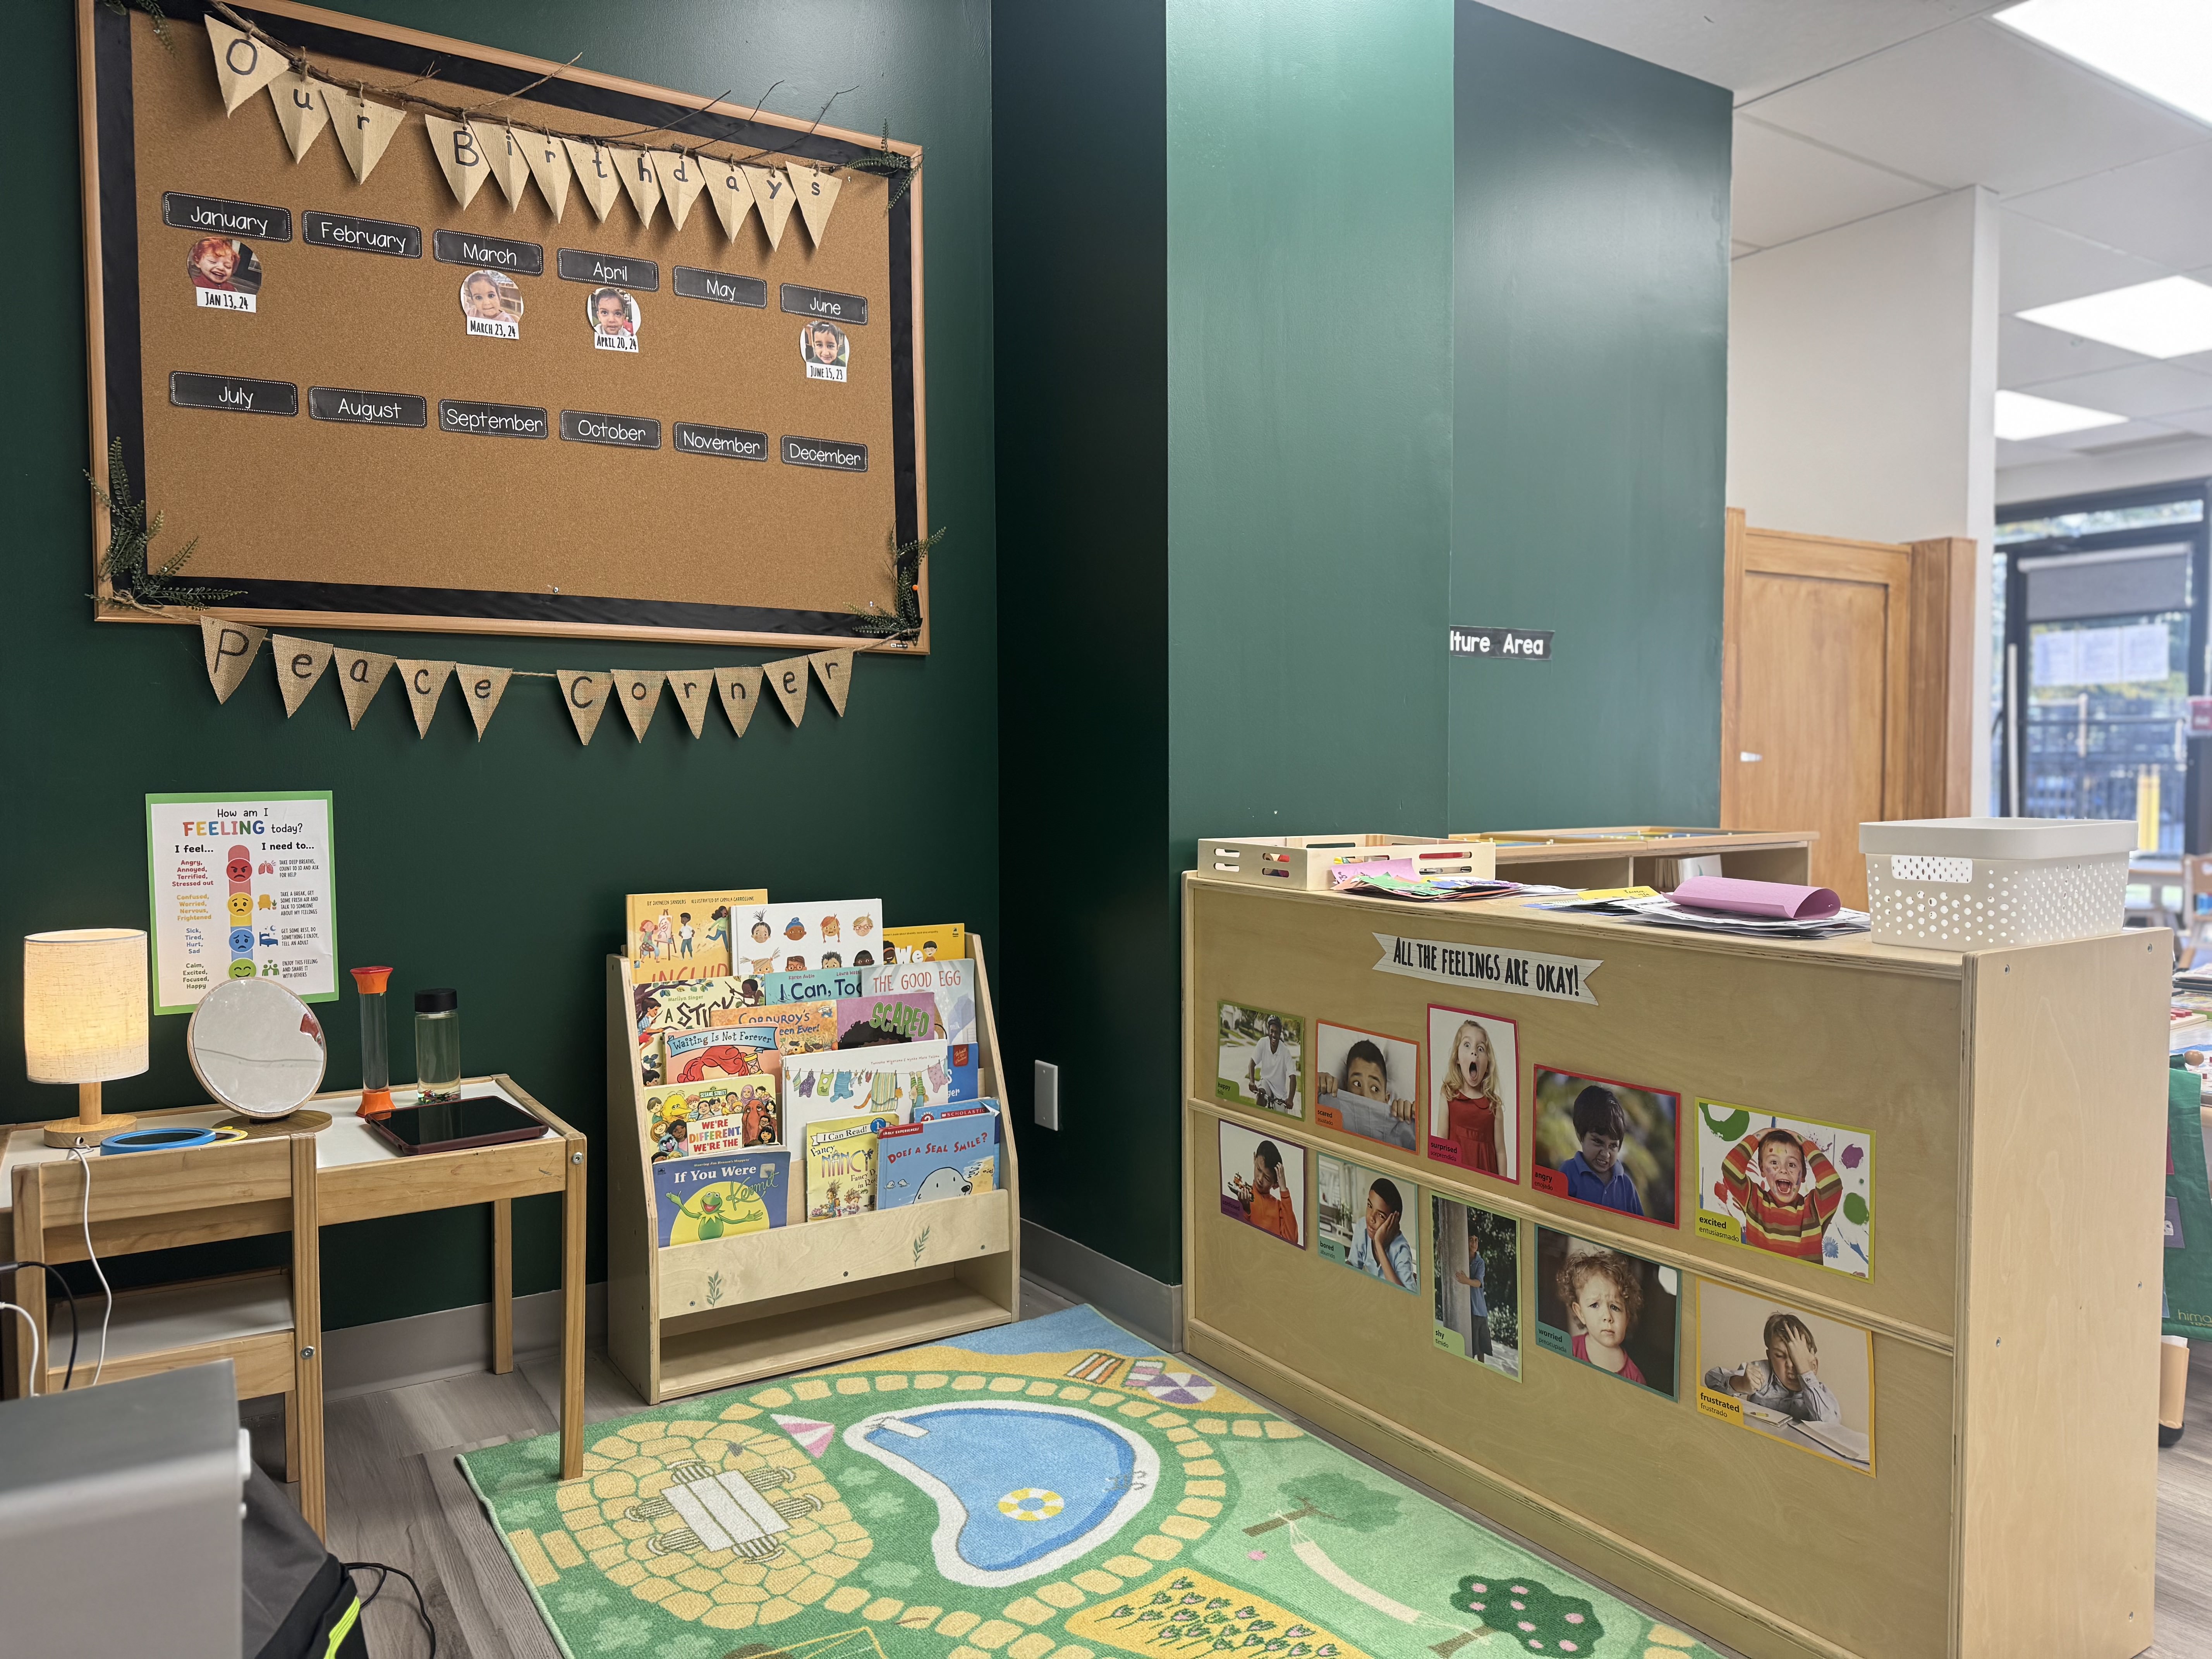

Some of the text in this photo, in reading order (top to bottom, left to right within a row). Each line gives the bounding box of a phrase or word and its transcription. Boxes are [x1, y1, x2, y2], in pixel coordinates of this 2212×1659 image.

[226, 38, 821, 199] Our Birthdays
[191, 206, 268, 235] January
[321, 222, 407, 253] February
[464, 242, 517, 266] March
[593, 262, 628, 283] April
[706, 279, 736, 301] May
[205, 291, 249, 310] JAN 13, 24
[810, 296, 841, 315] June
[470, 320, 516, 338] MARCH 23, 24
[596, 336, 637, 350] APRIL 20, 24
[809, 366, 843, 380] JUNE 15, 23
[219, 386, 253, 409] July
[338, 398, 402, 421] August
[447, 409, 543, 433] September
[578, 420, 646, 442] October
[684, 431, 760, 455] November
[790, 443, 860, 466] December
[1503, 634, 1543, 655] Area
[213, 629, 839, 709] Peace Corner
[217, 809, 237, 817] How
[264, 808, 268, 816] I
[183, 820, 302, 836] FEELING today?
[270, 842, 292, 850] need
[895, 945, 924, 964] We
[1393, 937, 1579, 996] ALL THE FEELINGS ARE OKAY!
[873, 970, 961, 993] THE GOOD EGG
[780, 984, 784, 1001] I
[791, 982, 831, 1000] Can,
[665, 1008, 673, 1024] A
[869, 1001, 929, 1037] SCARED
[797, 1024, 820, 1034] Ever!
[950, 1022, 960, 1030] milk
[673, 1036, 708, 1050] Waiting
[711, 1032, 719, 1042] Is
[722, 1031, 737, 1041] Not
[739, 1031, 772, 1043] Forever
[1218, 1082, 1231, 1091] happy
[946, 1108, 986, 1117] SCHOLASTIC
[702, 1119, 728, 1130] WE'RE
[846, 1126, 867, 1136] Read!
[694, 1138, 738, 1152] WE'RE THE
[811, 1146, 835, 1157] Fancy
[888, 1148, 912, 1164] DOES
[925, 1143, 948, 1154] SEAL
[954, 1132, 988, 1152] SMILE?
[1431, 1142, 1457, 1153] surprised
[822, 1149, 869, 1178] NANCY
[1431, 1151, 1456, 1161] sorprendida
[674, 1166, 757, 1183] If You Were
[851, 1173, 868, 1181] Fancy
[1535, 1172, 1553, 1183] angry
[726, 1171, 780, 1211] Kermit
[1535, 1182, 1553, 1190] enojado
[1699, 1217, 1726, 1229] excited
[1699, 1227, 1739, 1242] entusiasmado
[1320, 1240, 1334, 1251] bored
[1436, 1330, 1444, 1339] shy
[1539, 1329, 1562, 1343] worried
[1539, 1338, 1566, 1353] preocupada
[1700, 1392, 1740, 1413] frustrated
[1701, 1403, 1728, 1417] frustrado
